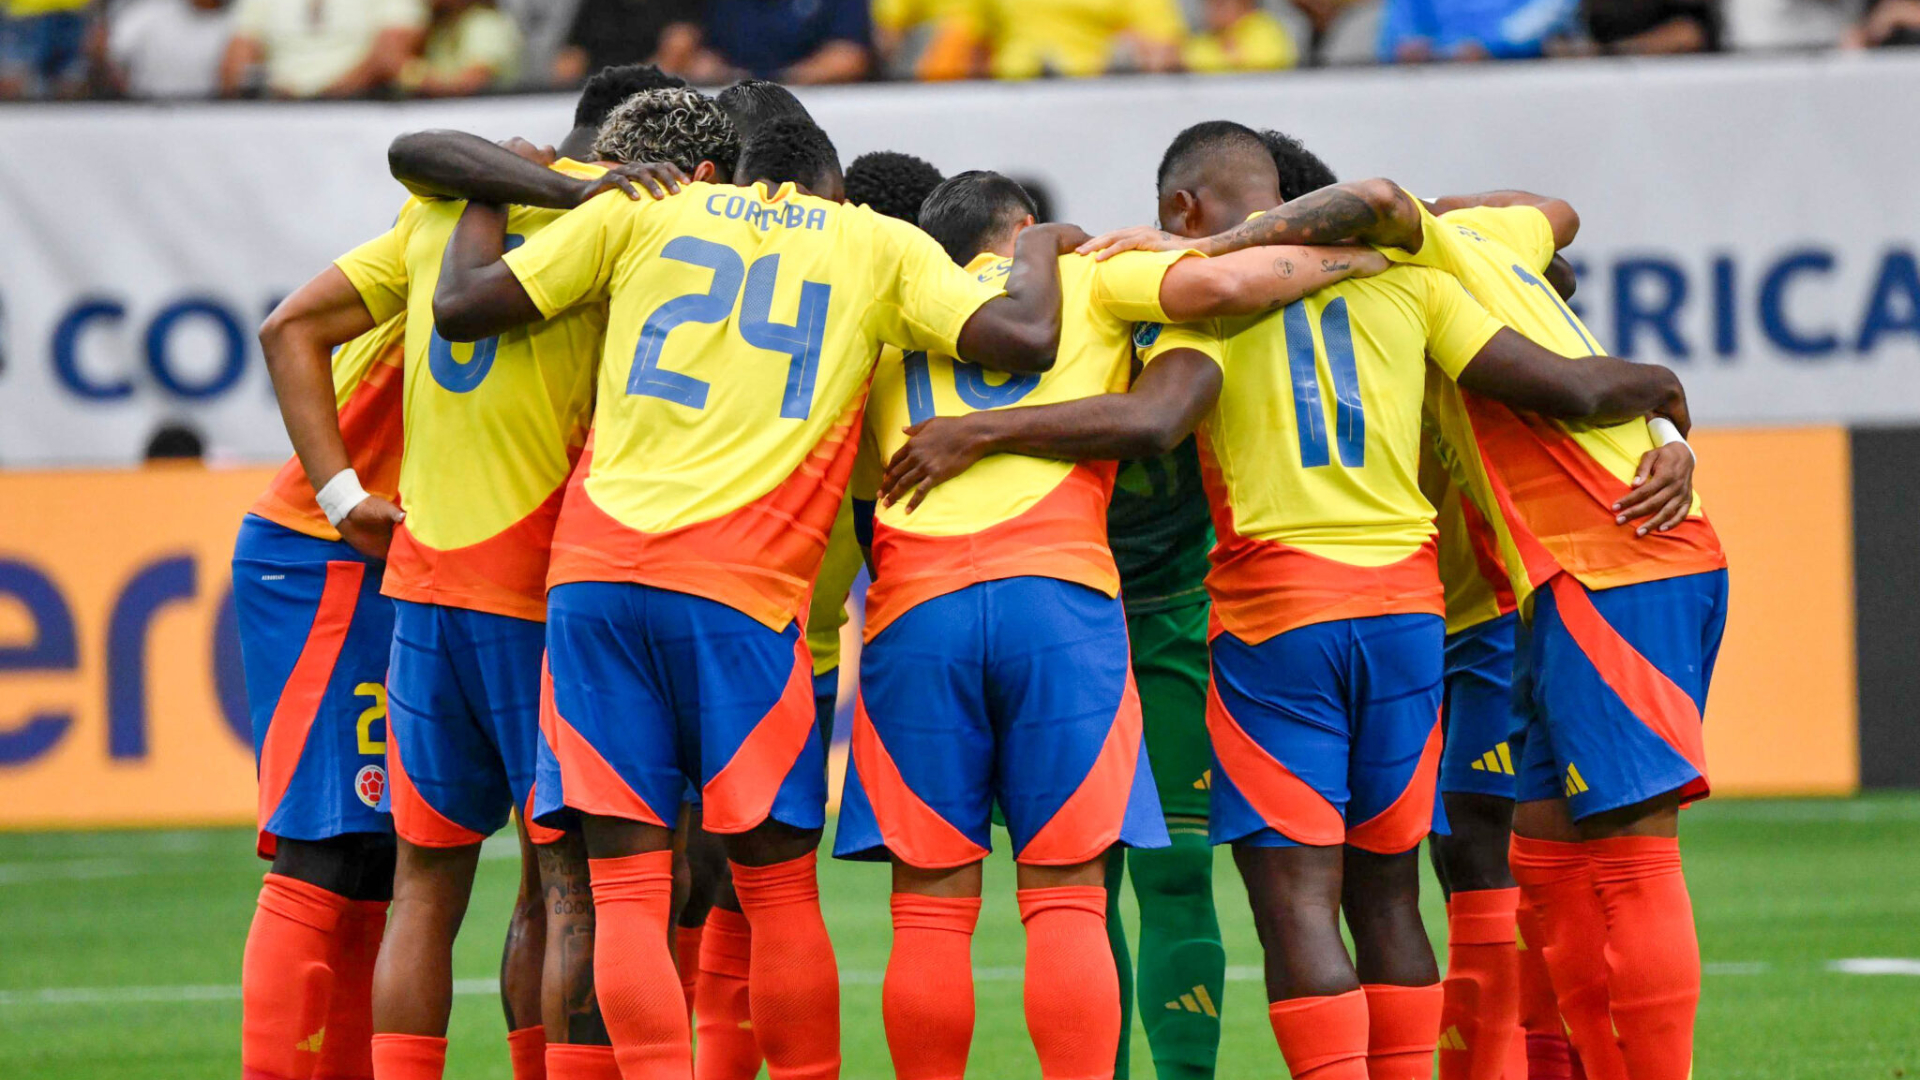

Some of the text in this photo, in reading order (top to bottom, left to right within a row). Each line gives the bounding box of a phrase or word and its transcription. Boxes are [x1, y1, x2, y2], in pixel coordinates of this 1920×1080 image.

[52, 298, 290, 402] CO
[625, 235, 831, 421] 24
[1574, 248, 1920, 358] RICA
[1283, 296, 1366, 469] 11
[554, 900, 592, 915] GOO
